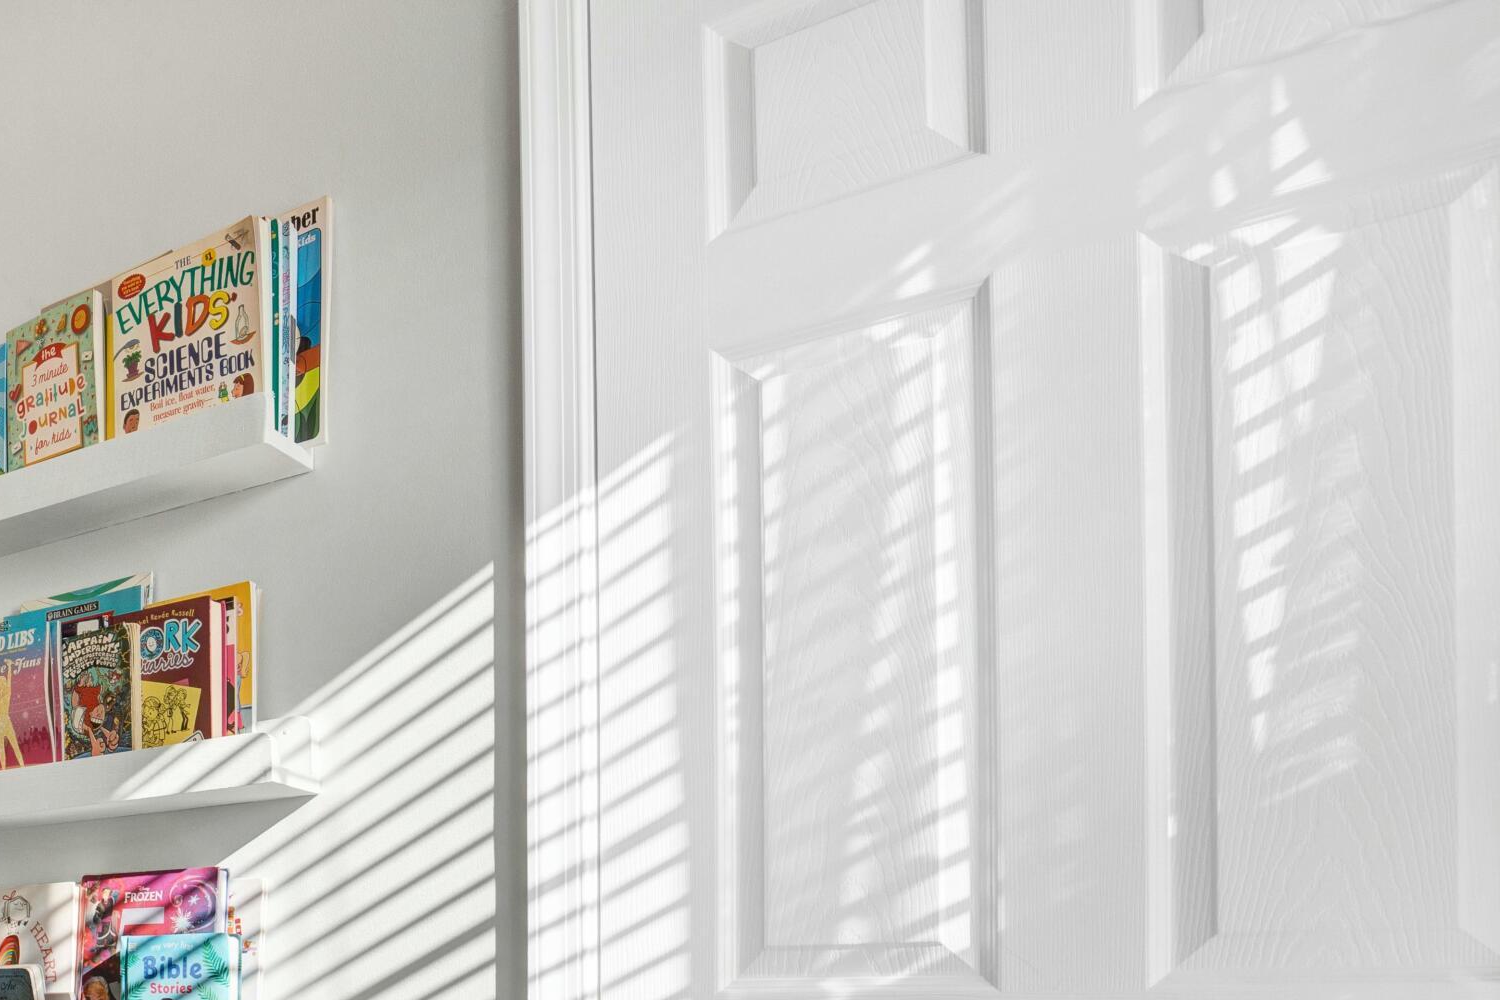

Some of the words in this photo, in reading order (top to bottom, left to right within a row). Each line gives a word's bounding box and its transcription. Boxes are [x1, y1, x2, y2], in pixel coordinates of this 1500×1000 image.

[174, 256, 192, 270] THE
[116, 251, 255, 335] EVERYTHING
[41, 346, 57, 361] the
[144, 331, 228, 384] SCIENCE
[31, 374, 38, 387] 3
[38, 362, 69, 384] minute
[120, 363, 214, 411] EXPERIMENTS
[220, 349, 255, 377] BOOK
[153, 406, 182, 422] measure
[35, 438, 50, 455] for
[52, 428, 72, 444] kids
[53, 608, 74, 619] BRAIN
[74, 603, 98, 615] GAMES
[7, 628, 37, 651] LIBS
[141, 618, 203, 661] ORK
[14, 657, 42, 675] Fans
[141, 652, 195, 675] iaries
[123, 890, 163, 904] FROZEN
[30, 920, 57, 983] HEART
[142, 955, 202, 980] Bible
[150, 981, 193, 994] Stories
